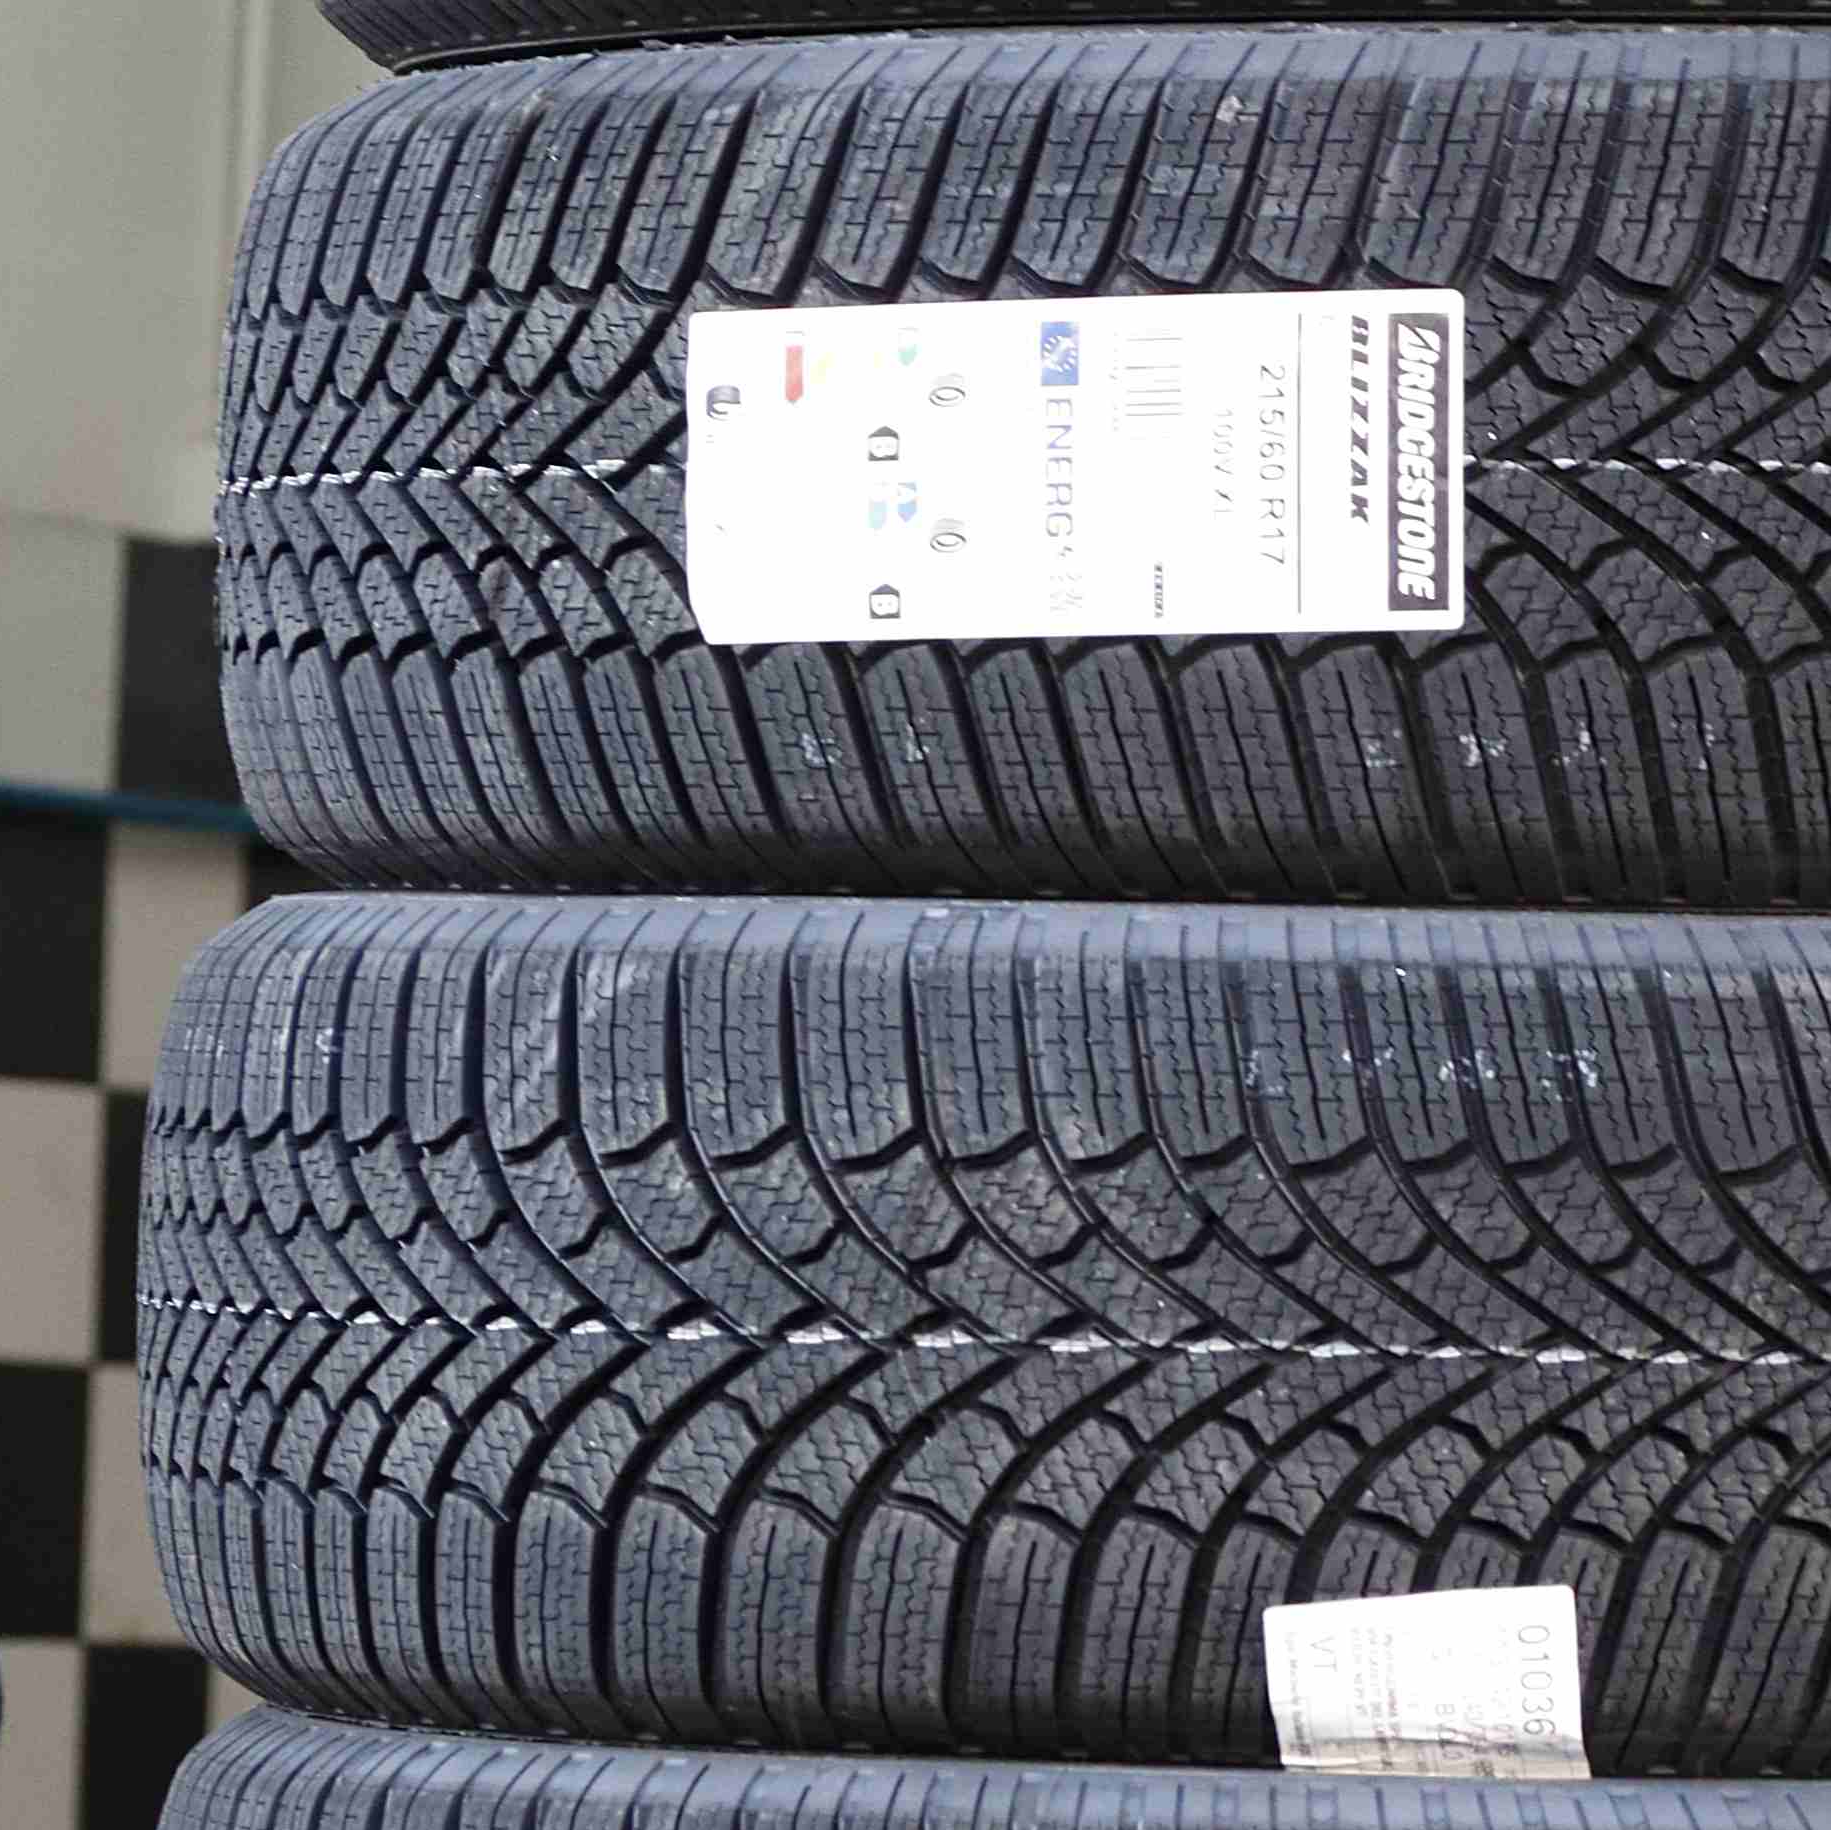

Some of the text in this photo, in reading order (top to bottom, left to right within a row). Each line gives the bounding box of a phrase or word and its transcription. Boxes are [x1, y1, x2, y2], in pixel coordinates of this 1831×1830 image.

[1257, 364, 1287, 566] 215/60 R17
[1349, 314, 1370, 523] BLIZZAK
[1396, 322, 1442, 604] BRIDGESTONE
[1517, 1624, 1556, 1737] 01036
